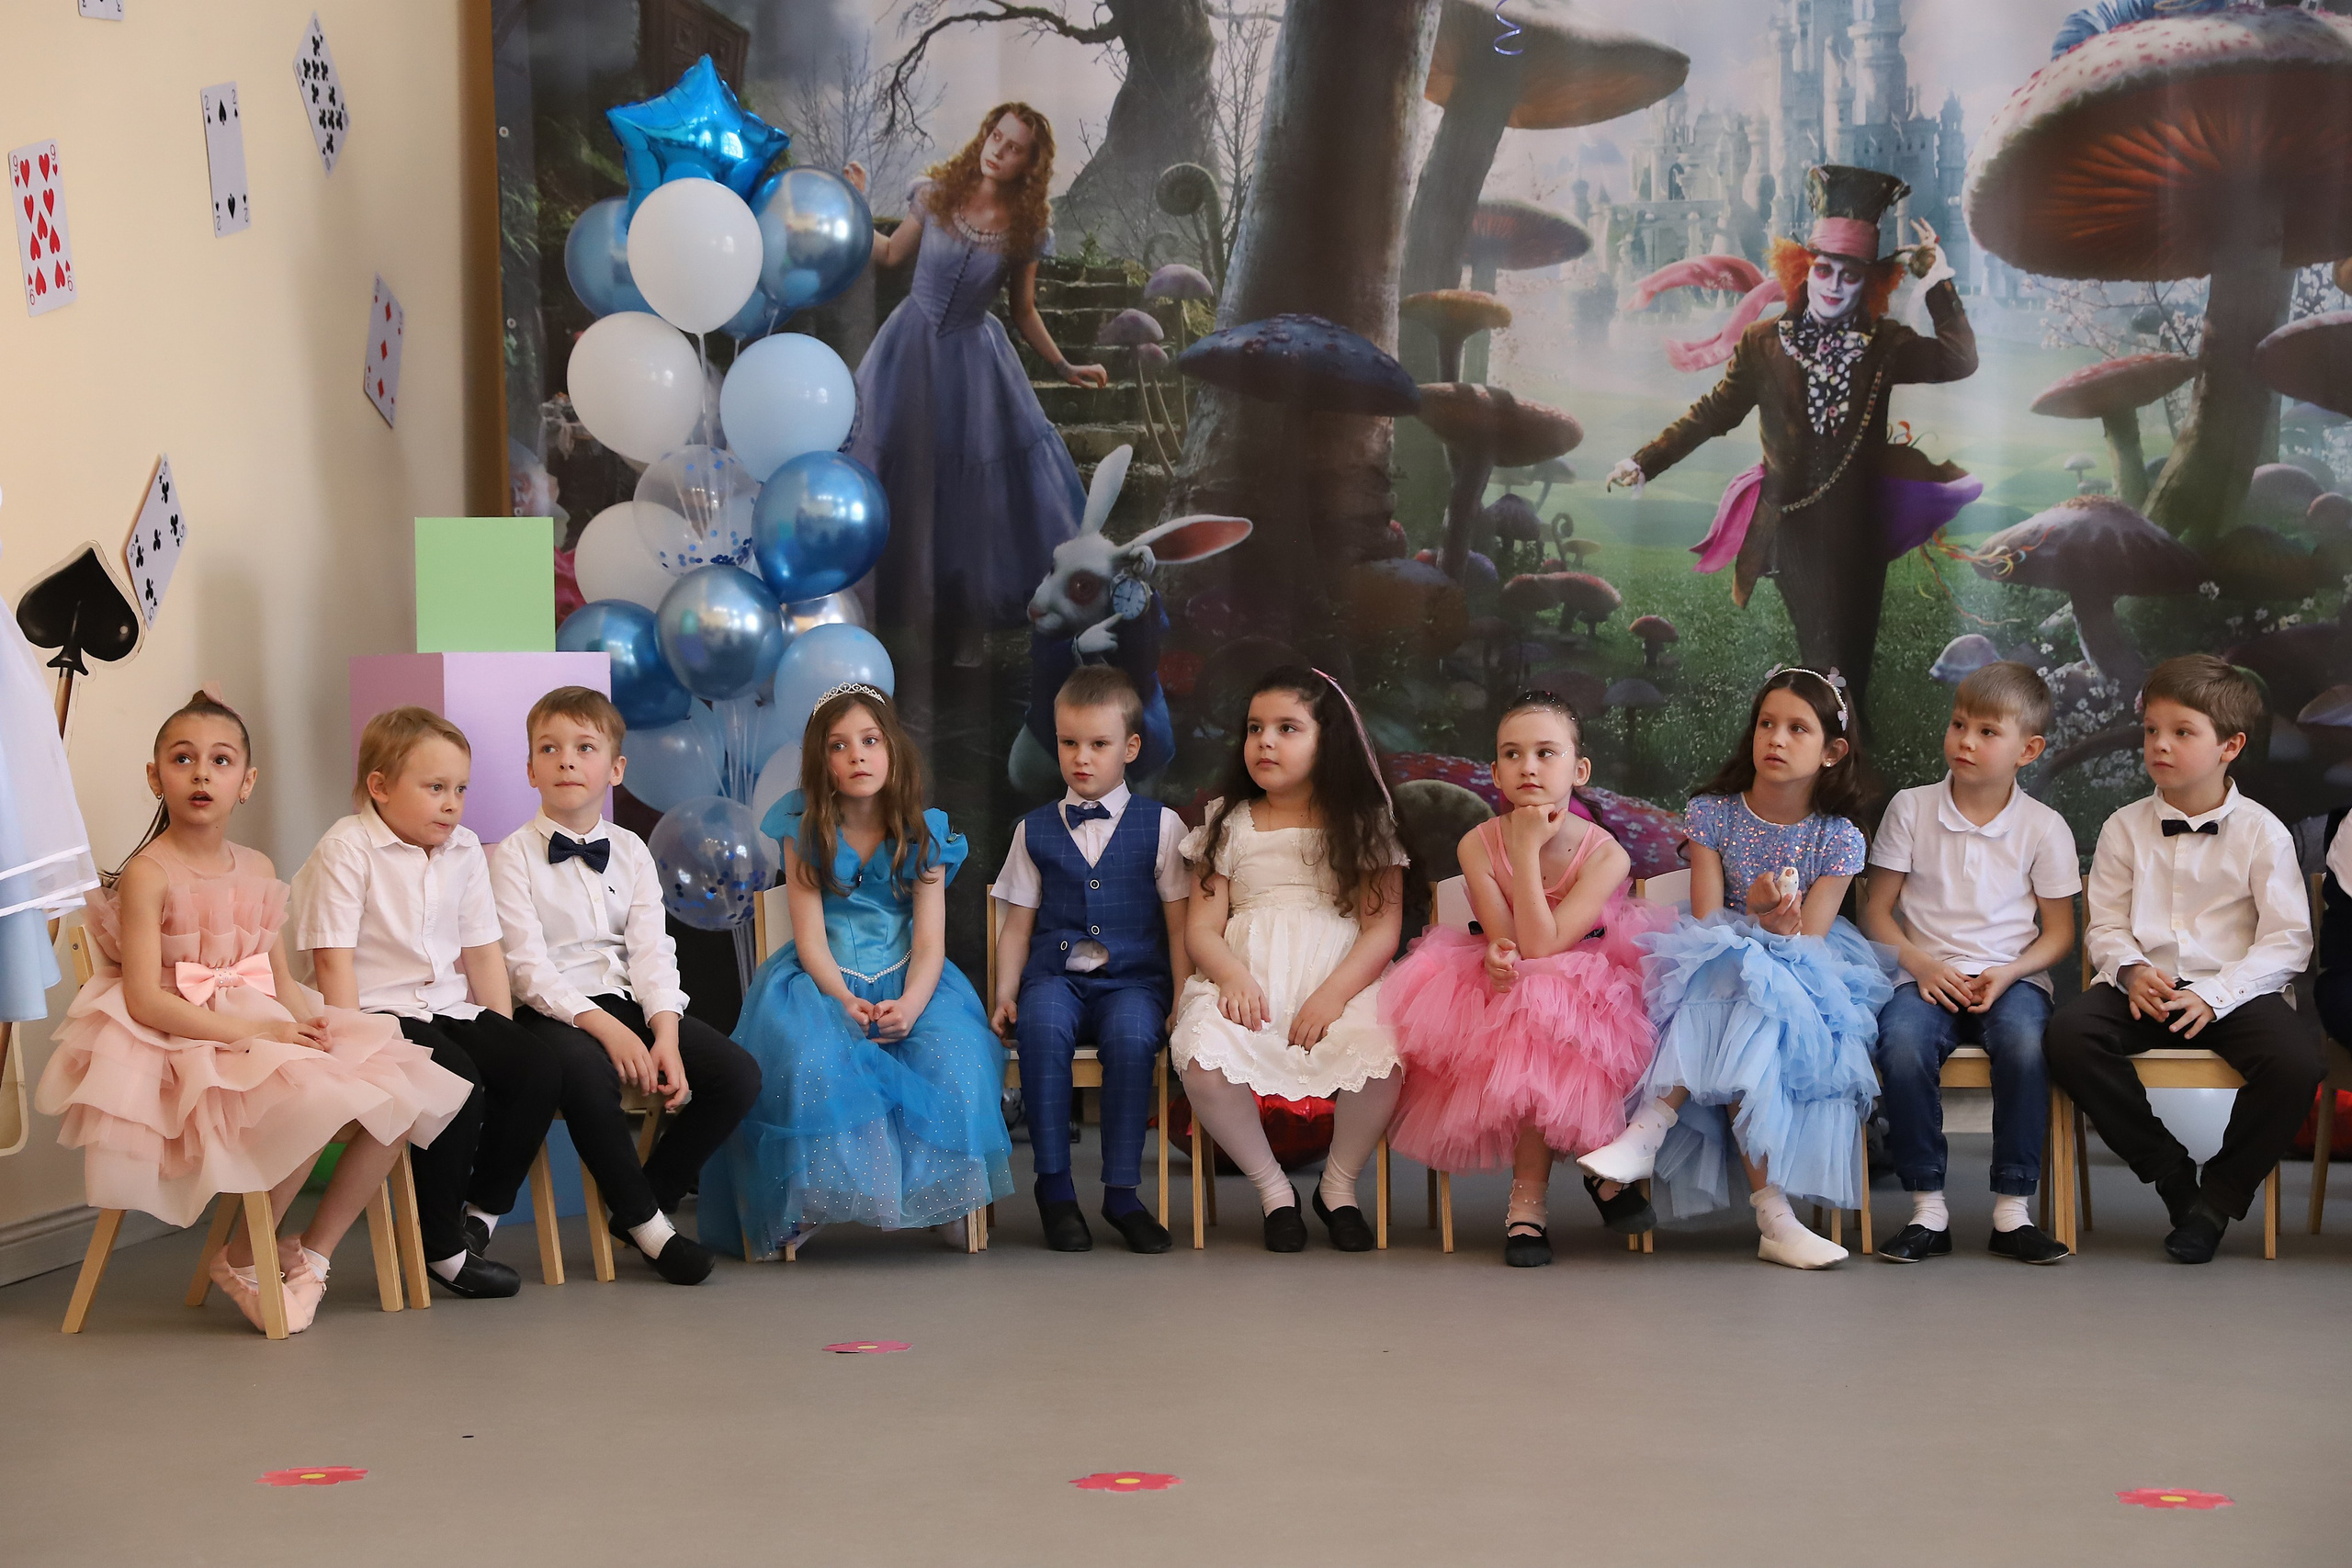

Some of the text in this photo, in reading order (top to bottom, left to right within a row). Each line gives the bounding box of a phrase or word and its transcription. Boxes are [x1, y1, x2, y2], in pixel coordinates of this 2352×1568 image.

[204, 95, 209, 110] 2
[232, 88, 236, 105] 2
[50, 143, 56, 161] 9
[13, 154, 18, 172] 9
